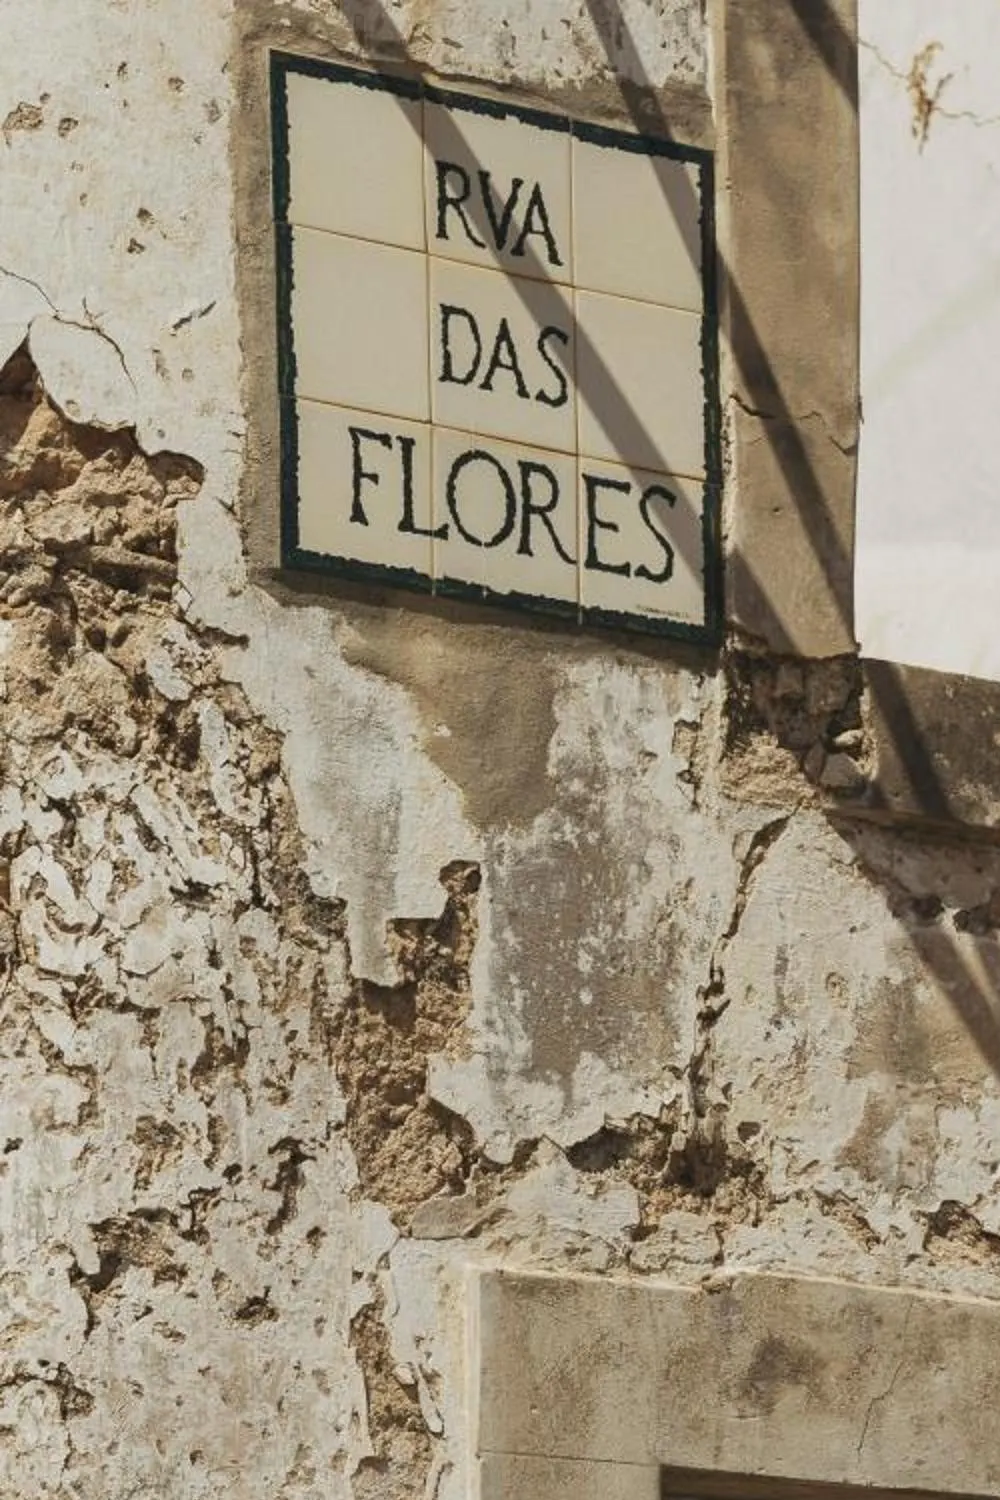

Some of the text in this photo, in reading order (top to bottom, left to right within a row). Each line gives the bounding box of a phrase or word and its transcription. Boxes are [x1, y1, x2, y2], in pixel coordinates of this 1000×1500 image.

[434, 159, 564, 267] RVA
[437, 303, 570, 408] DAS
[348, 427, 677, 583] FLORES
